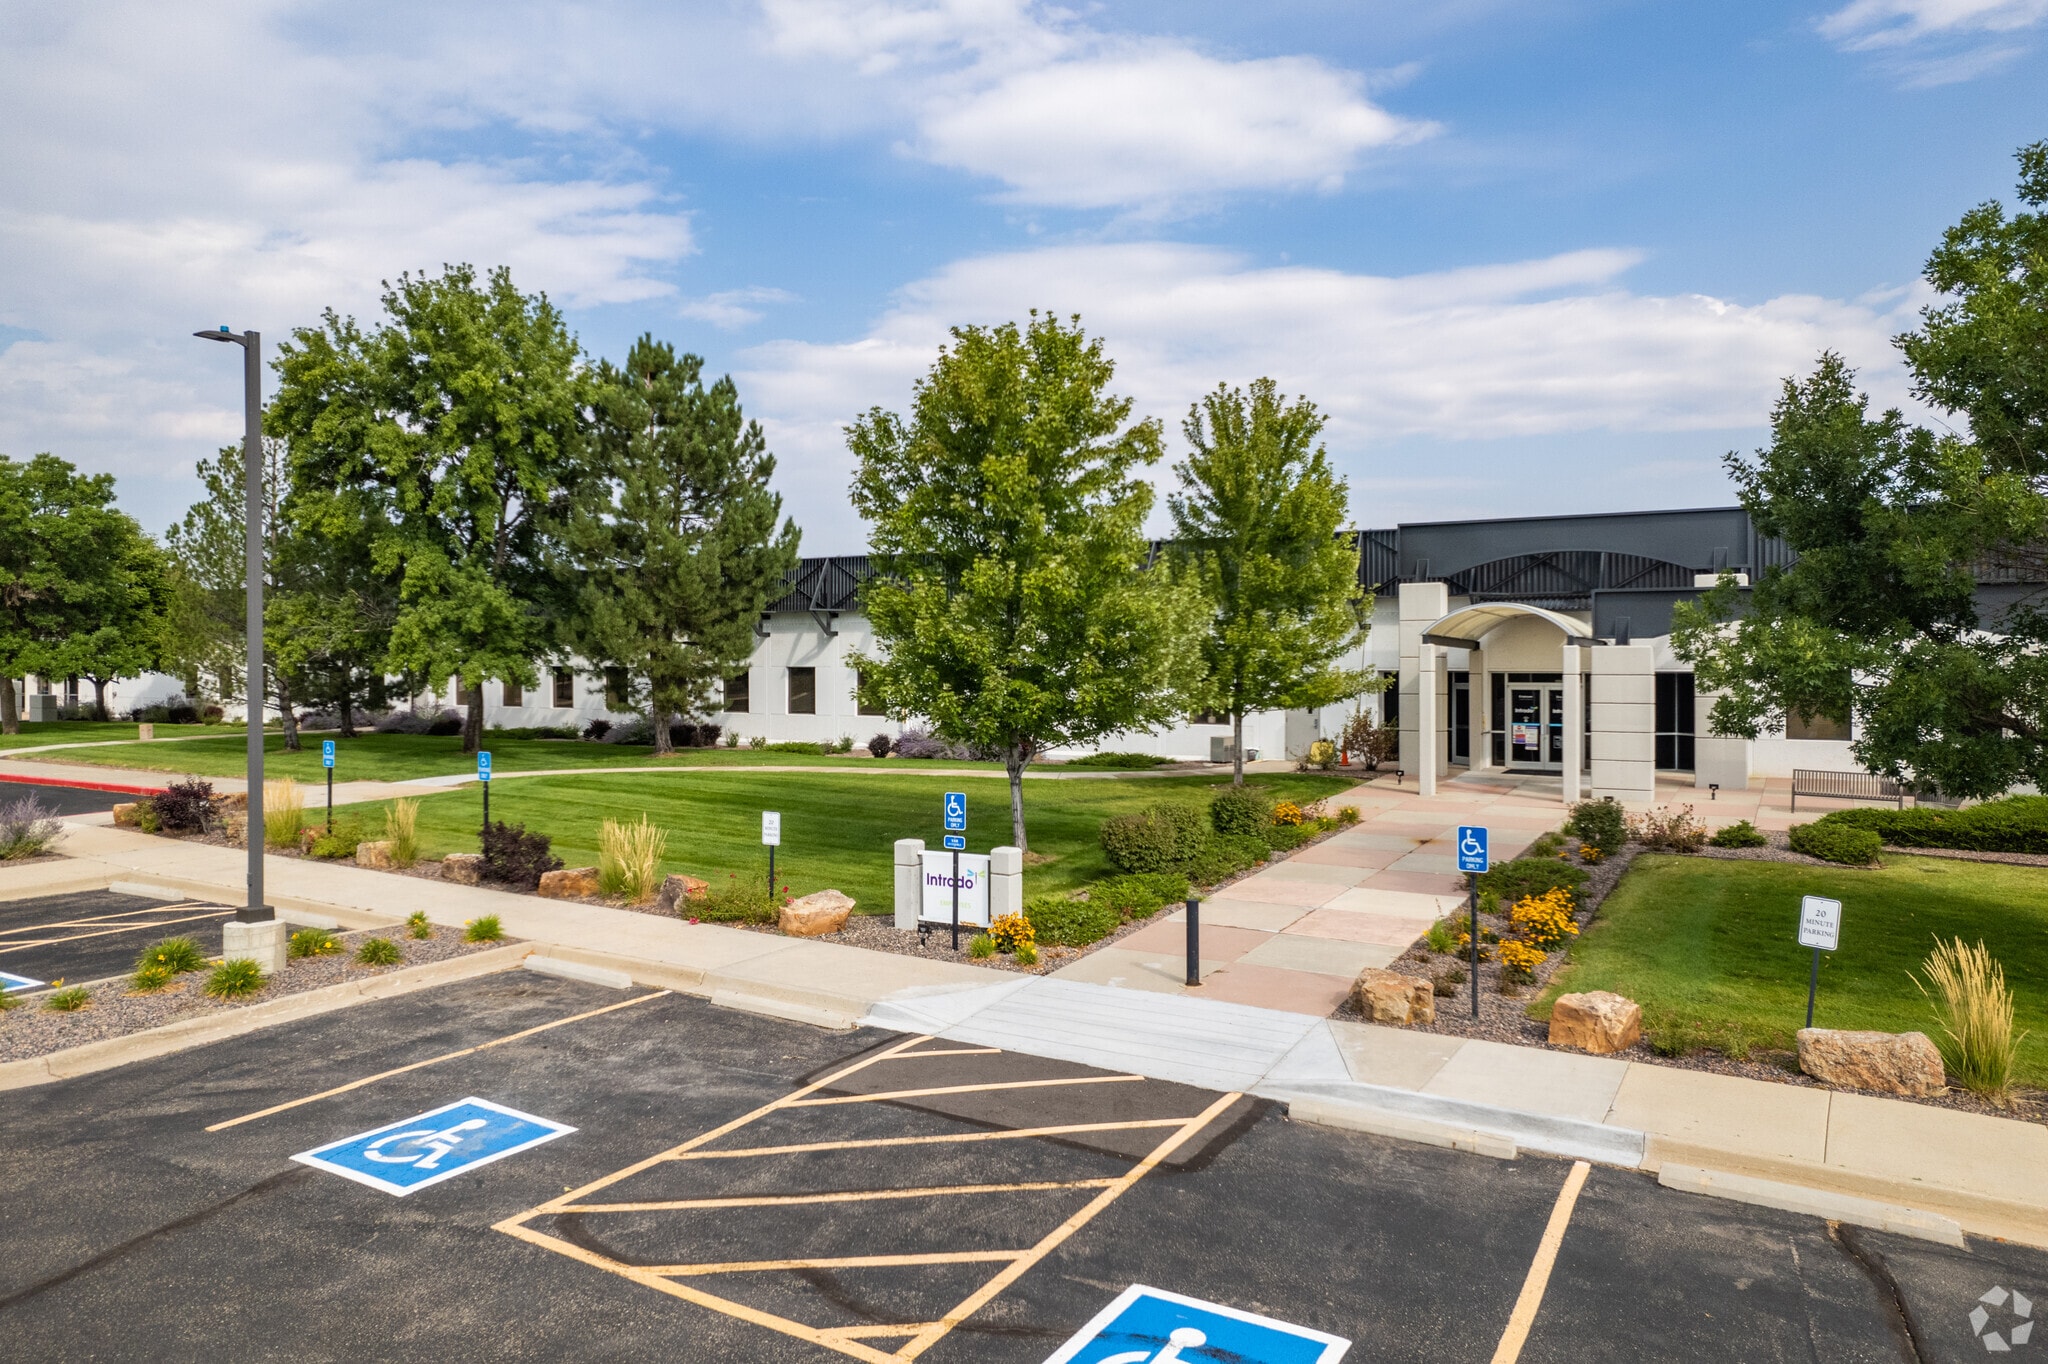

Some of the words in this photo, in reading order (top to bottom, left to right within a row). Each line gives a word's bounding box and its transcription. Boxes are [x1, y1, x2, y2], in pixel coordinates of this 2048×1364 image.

[1461, 856, 1484, 864] PARKING
[926, 872, 974, 890] Intrado
[1815, 909, 1827, 918] 20
[1805, 918, 1835, 929] MINUTE
[1803, 927, 1835, 938] PARKING
